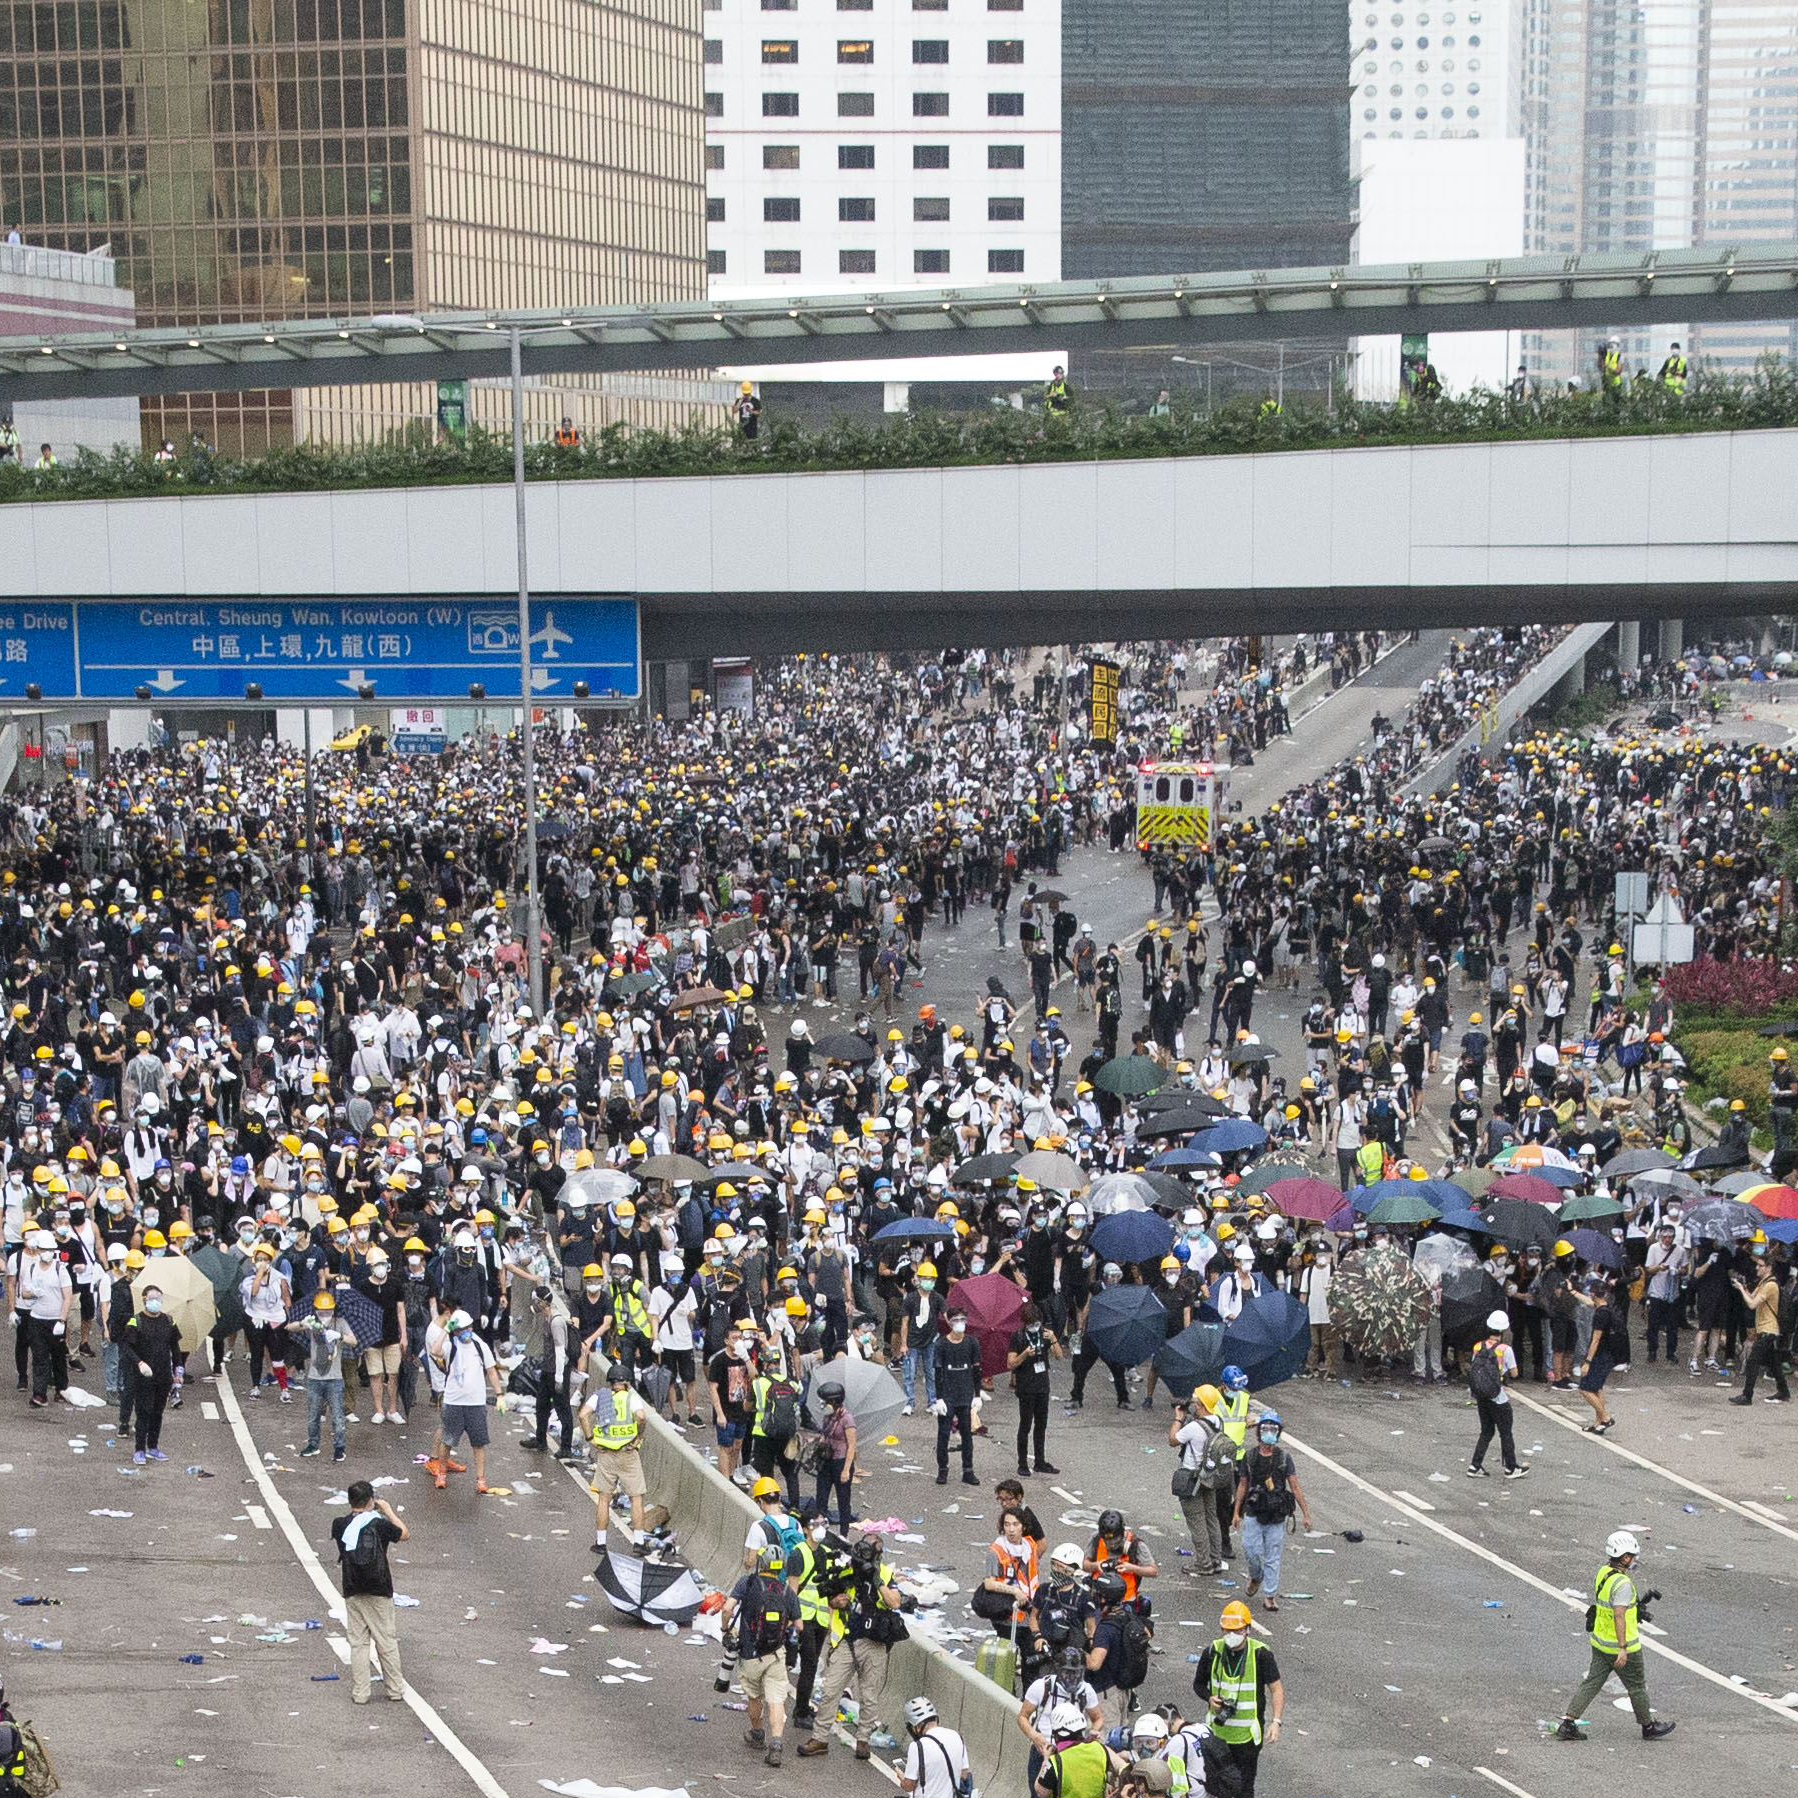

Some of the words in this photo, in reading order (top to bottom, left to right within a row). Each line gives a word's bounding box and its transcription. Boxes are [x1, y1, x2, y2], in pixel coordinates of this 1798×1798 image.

[23, 613, 68, 630] Drive
[139, 609, 211, 626] Central,
[218, 609, 283, 629] Sheung
[341, 608, 418, 625] Kowloon
[427, 607, 461, 627] (W)
